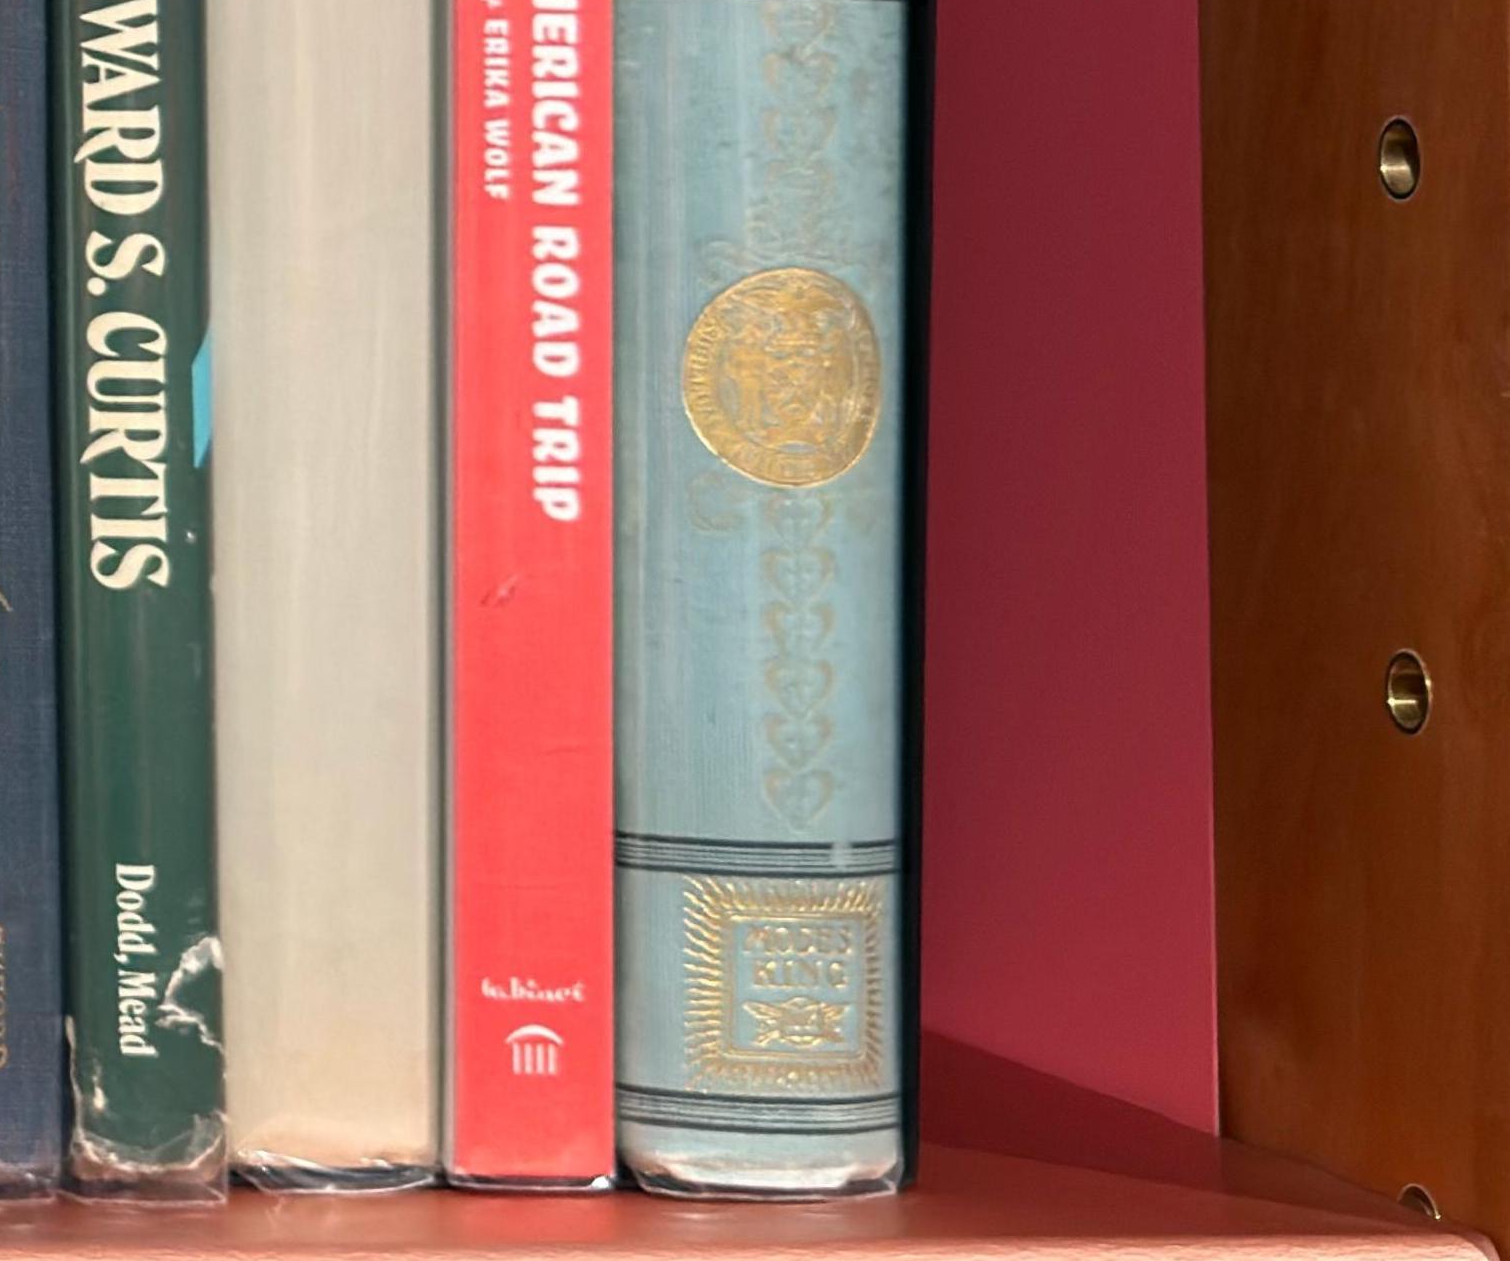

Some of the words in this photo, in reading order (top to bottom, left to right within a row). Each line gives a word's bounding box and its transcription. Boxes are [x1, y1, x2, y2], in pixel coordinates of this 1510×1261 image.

[84, 230, 166, 296] S.
[531, 225, 582, 379] ROAD
[79, 311, 171, 592] CURTIS
[532, 394, 582, 523] TRIP
